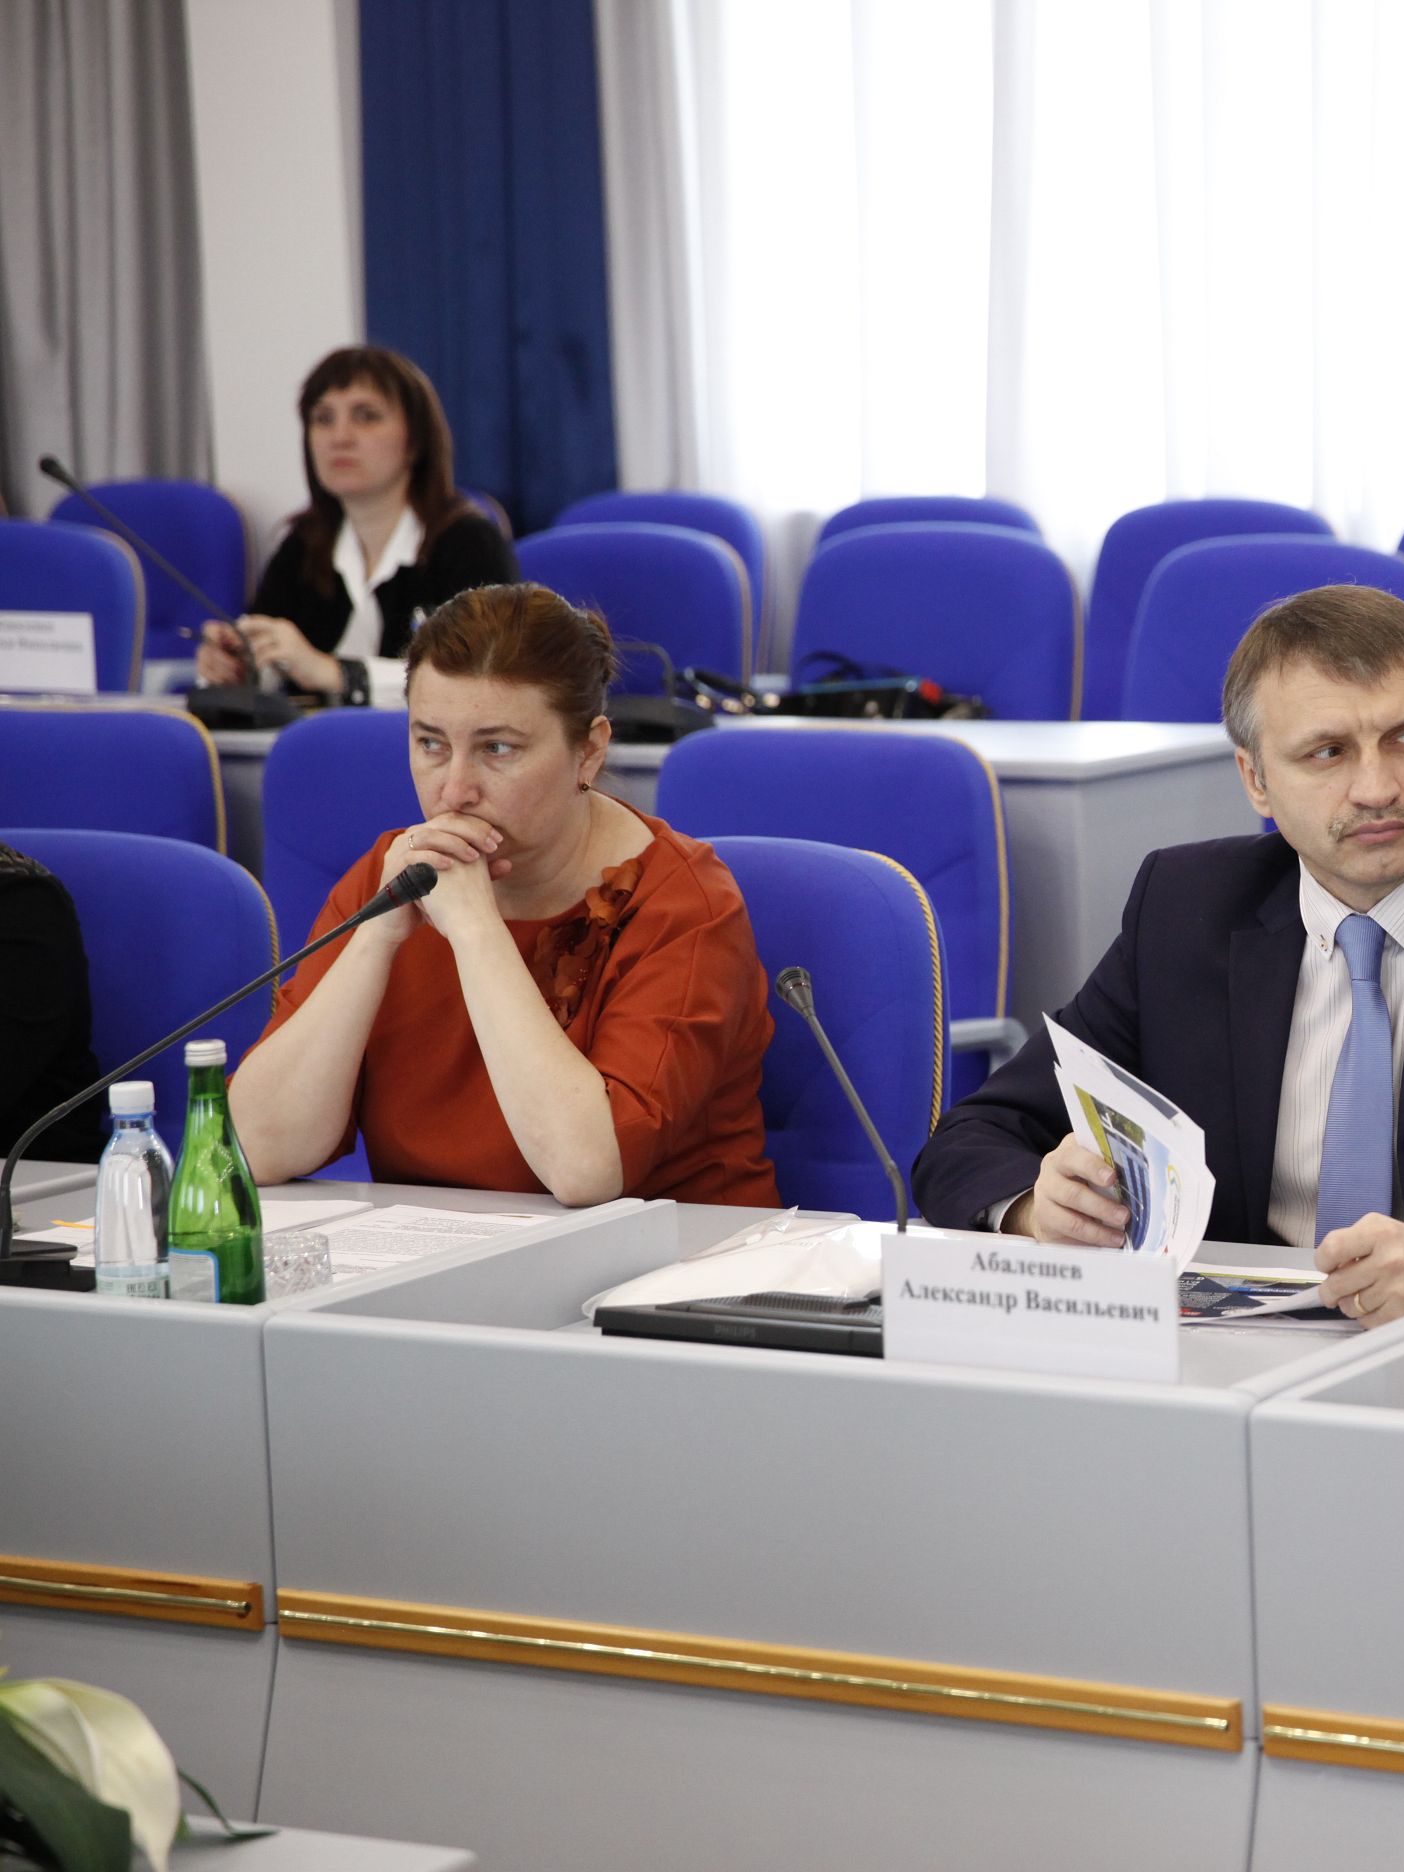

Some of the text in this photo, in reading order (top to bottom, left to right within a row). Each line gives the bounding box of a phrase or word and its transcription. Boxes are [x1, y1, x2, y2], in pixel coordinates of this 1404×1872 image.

[971, 1251, 1083, 1280] Абалешев
[901, 1279, 1018, 1314] Александр
[1026, 1290, 1160, 1323] Васильевич
